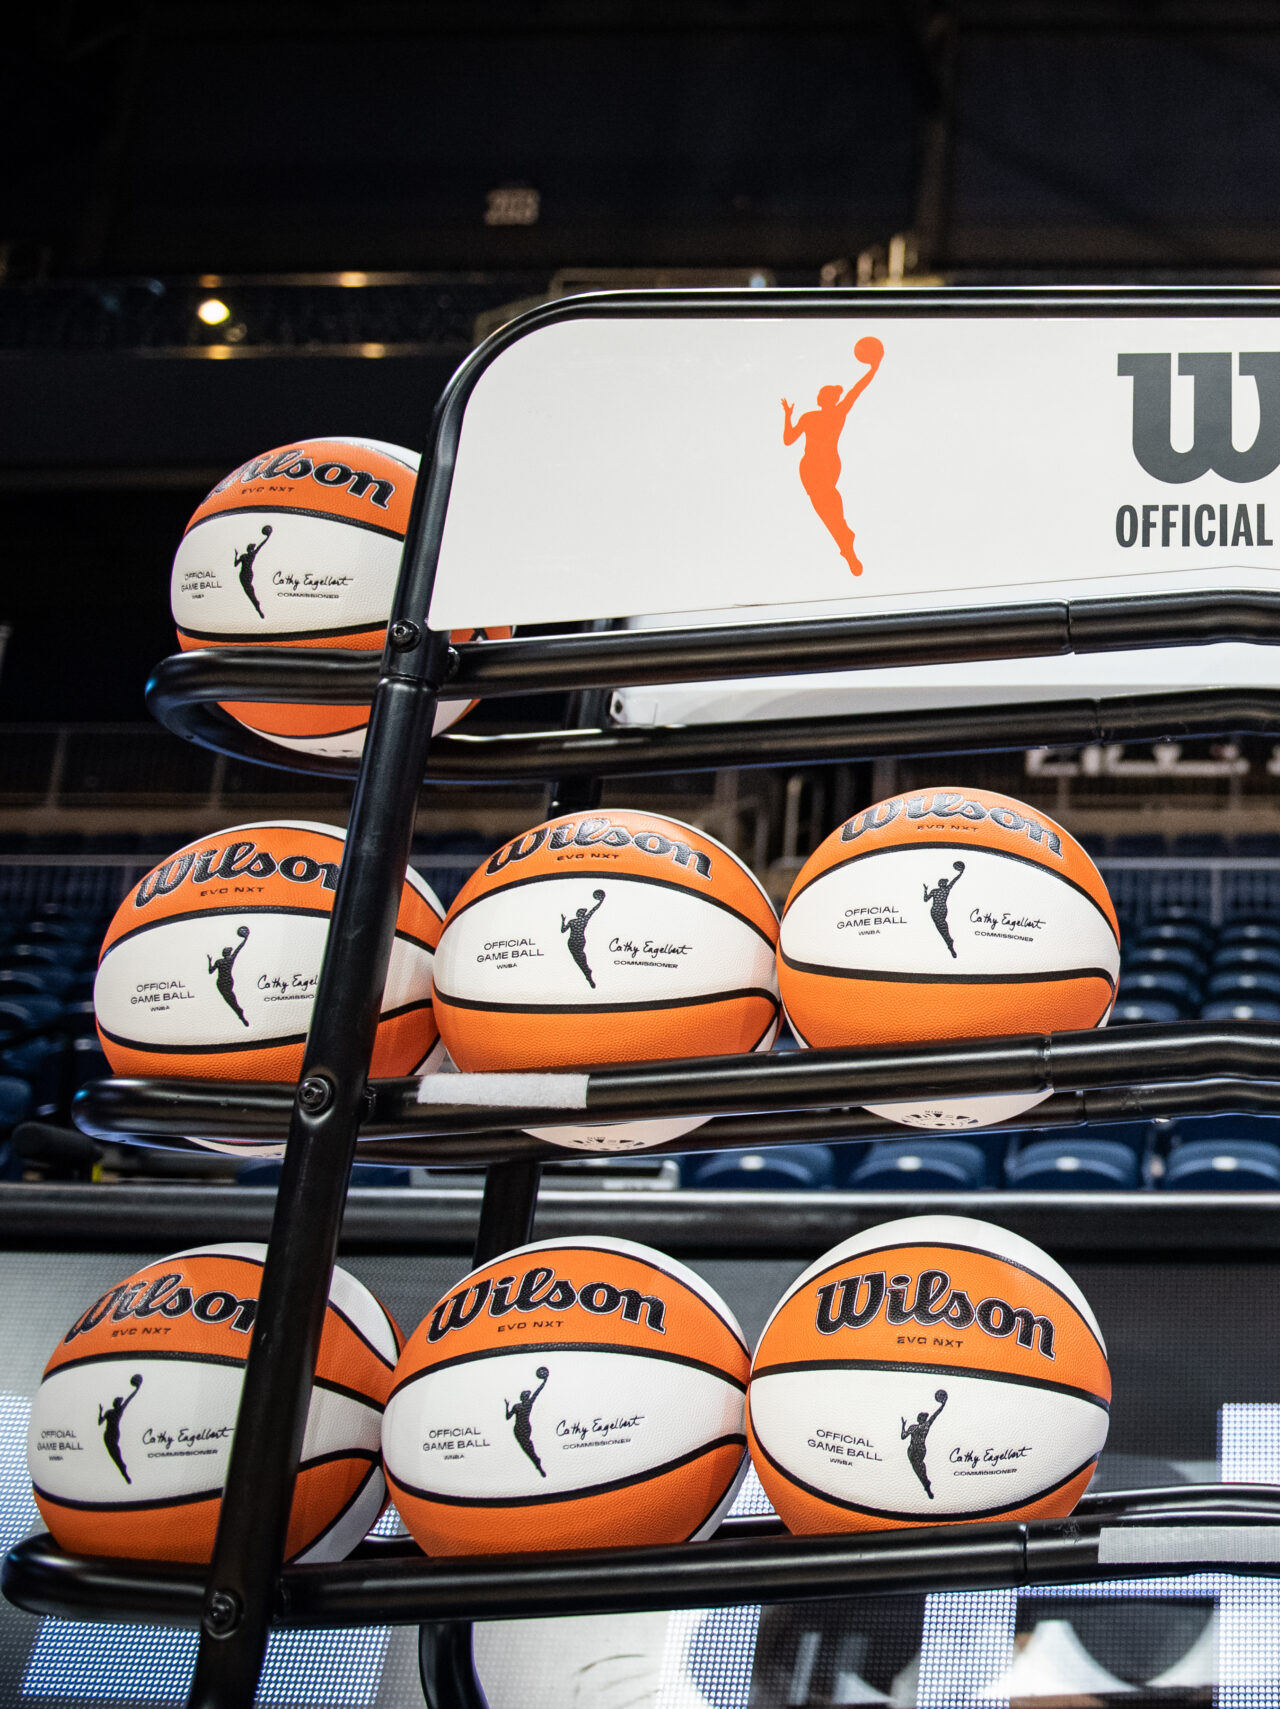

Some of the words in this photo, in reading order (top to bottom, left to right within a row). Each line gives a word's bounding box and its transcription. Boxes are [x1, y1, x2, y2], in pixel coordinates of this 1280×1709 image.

[1116, 503, 1273, 548] OFFICIAL
[200, 582, 223, 590] BALL
[839, 792, 1064, 860] Wilson
[485, 818, 713, 881] Wilson
[557, 853, 584, 861] EVO
[200, 888, 229, 897] EVO
[844, 905, 900, 918] OFFICIAL
[836, 918, 871, 929] GAME
[874, 915, 908, 925] BALL
[974, 930, 1034, 942] COMMISSIONER
[484, 938, 536, 951] OFFICIAL
[477, 951, 508, 963] GAME
[512, 949, 544, 958] BALL
[613, 959, 678, 969] COMMISSIONER
[136, 981, 186, 993] OFFICIAL
[131, 994, 160, 1005] GAME
[163, 992, 195, 1000] BALL
[426, 1267, 667, 1344] Wilson
[815, 1268, 1056, 1362] Wilson
[141, 1327, 172, 1335] NXT
[497, 1322, 527, 1332] EVO
[532, 1320, 565, 1329] NXT
[897, 1336, 927, 1345] EVO
[933, 1338, 964, 1349] NXT
[40, 1430, 77, 1440] OFFICIAL
[428, 1427, 481, 1439] OFFICIAL
[816, 1429, 875, 1448] OFFICIAL
[37, 1442, 57, 1451] GAME
[58, 1441, 84, 1451] BALL
[423, 1442, 455, 1452] GAME
[457, 1439, 491, 1449] BALL
[562, 1438, 631, 1450] COMMISSIONER
[807, 1439, 844, 1455] GAME
[846, 1447, 883, 1461] BALL
[147, 1449, 218, 1459] COMMISSIONER
[829, 1457, 853, 1466] WNBA
[953, 1468, 1018, 1477] COMMISSIONER
